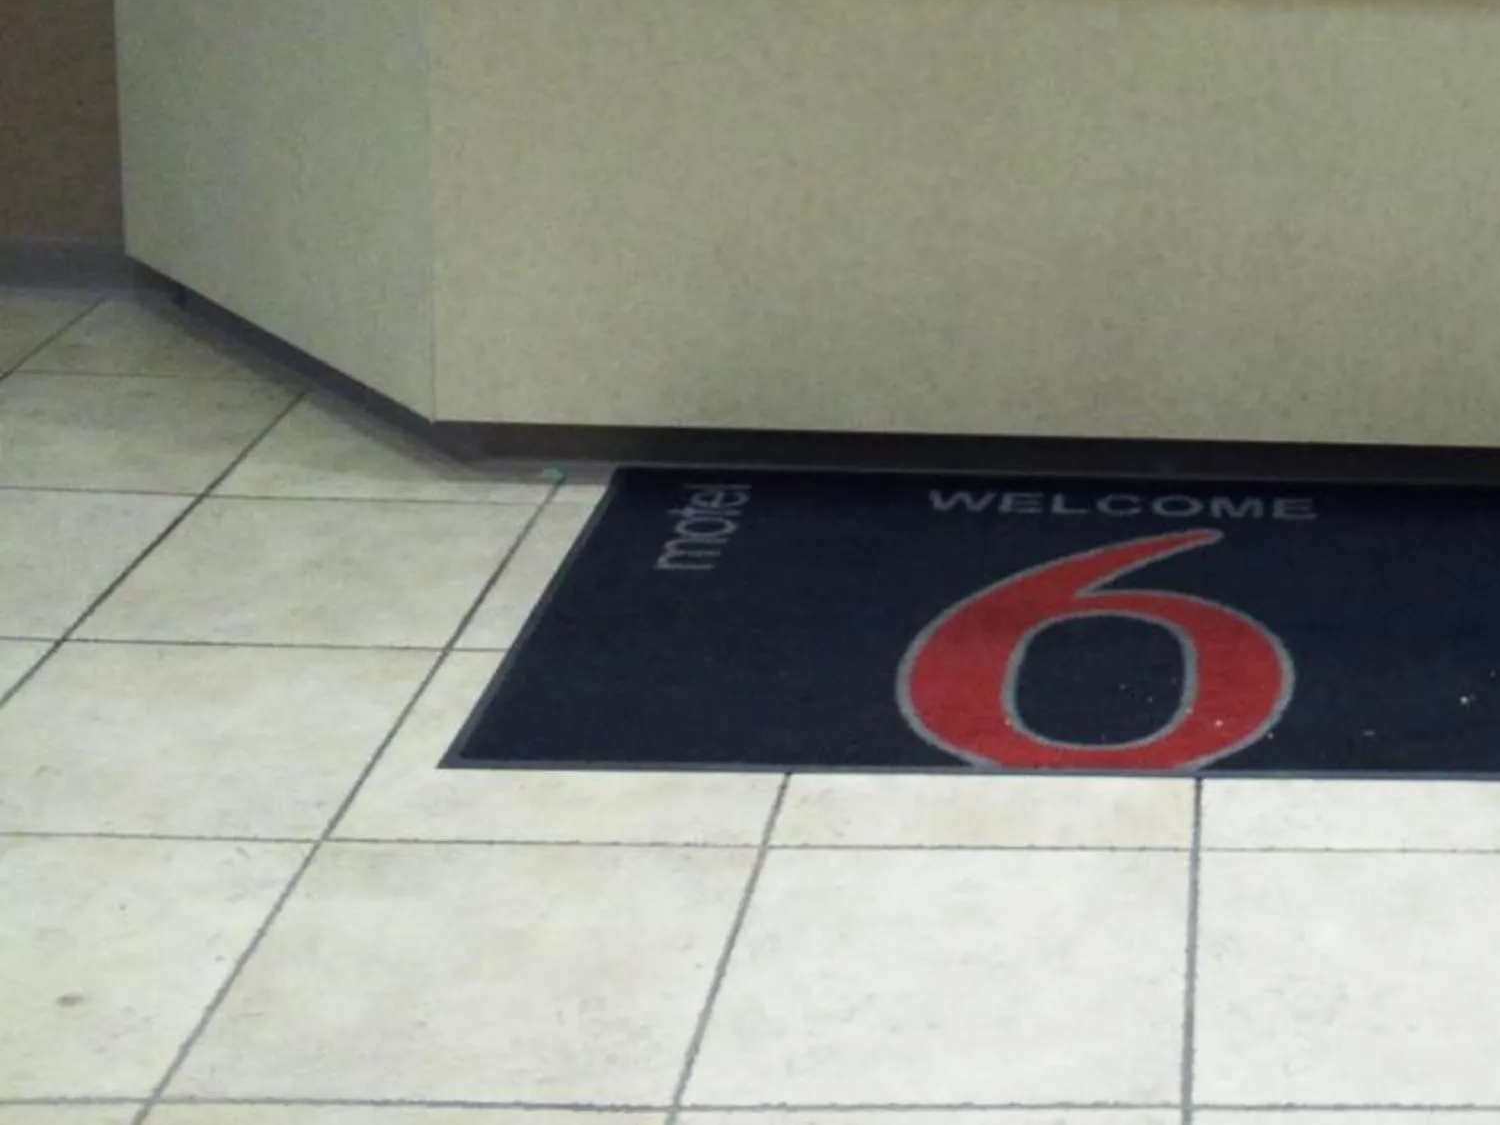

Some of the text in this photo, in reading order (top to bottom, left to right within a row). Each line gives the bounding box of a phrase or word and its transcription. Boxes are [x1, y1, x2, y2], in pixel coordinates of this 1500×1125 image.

[655, 483, 752, 570] motel
[928, 489, 1319, 520] WELCOME
[895, 528, 1296, 772] 6
